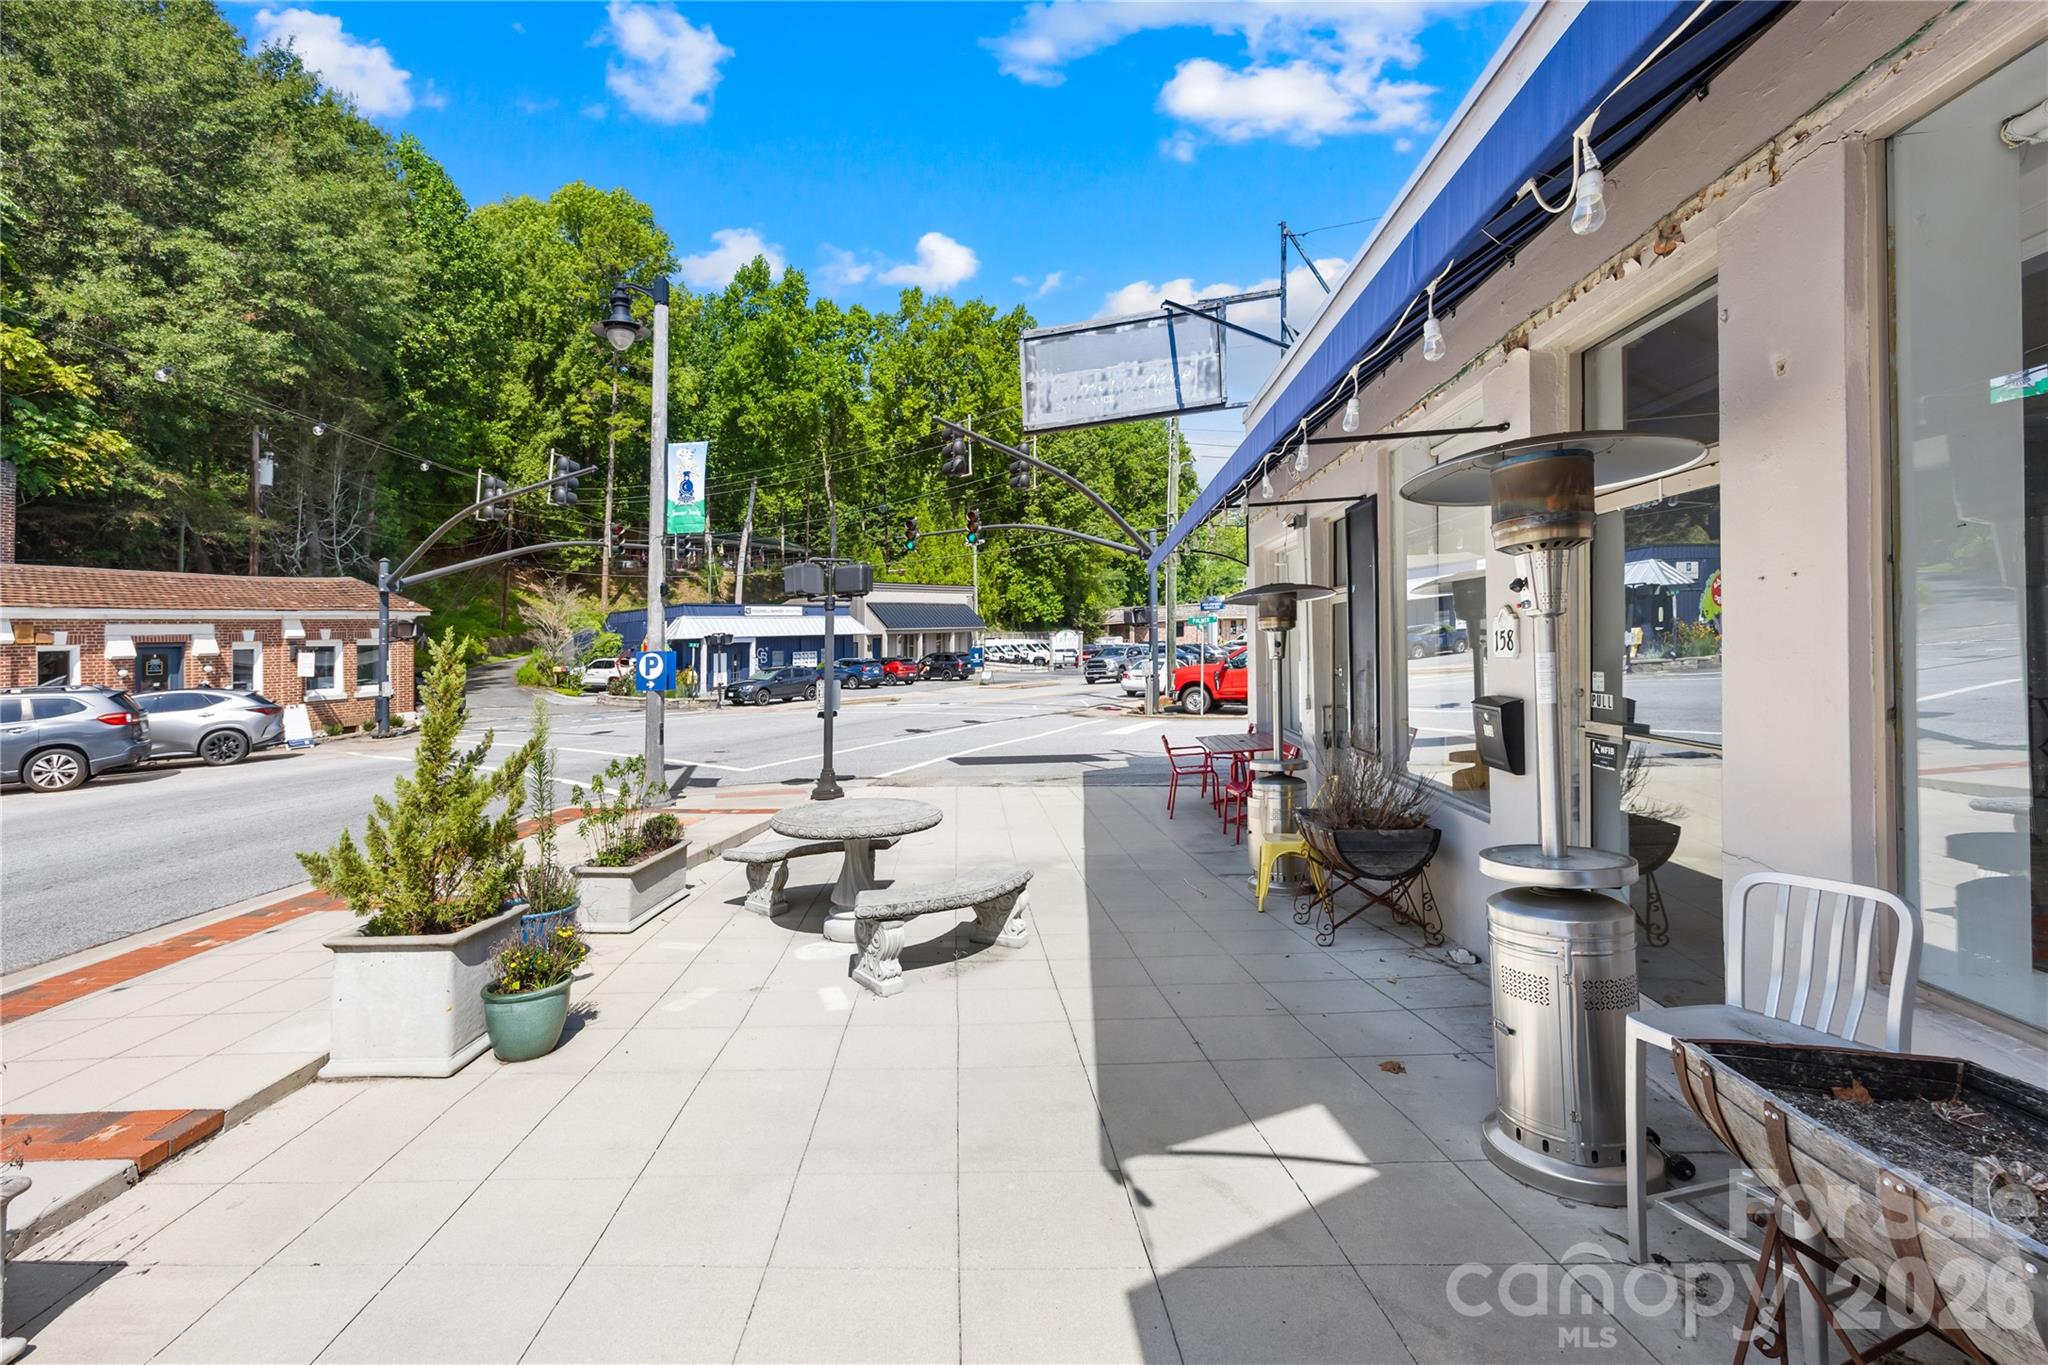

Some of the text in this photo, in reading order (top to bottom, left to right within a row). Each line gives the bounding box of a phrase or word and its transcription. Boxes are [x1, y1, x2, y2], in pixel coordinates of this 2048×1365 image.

[1495, 629, 1514, 652] 158
[645, 656, 659, 676] P
[1592, 694, 1612, 709] PULL
[1600, 745, 1615, 755] NFIB
